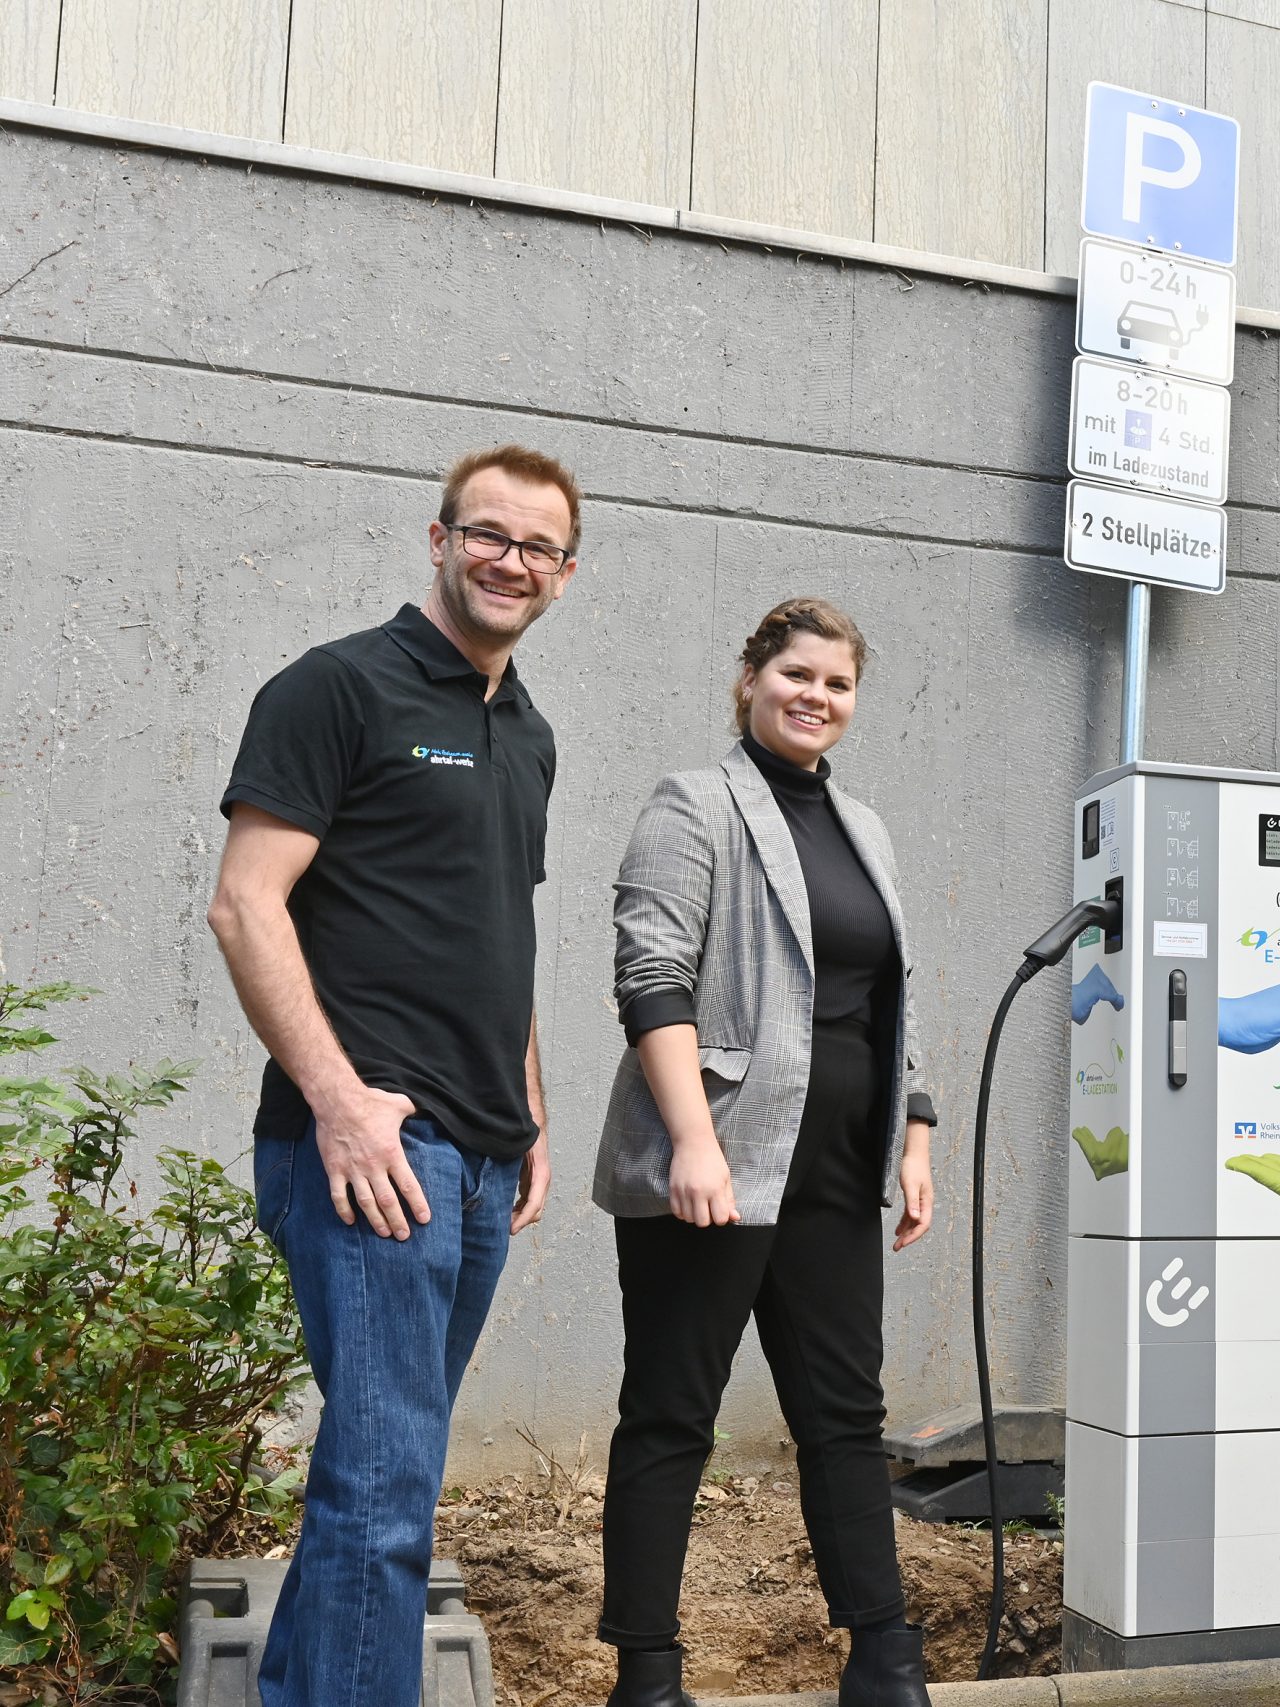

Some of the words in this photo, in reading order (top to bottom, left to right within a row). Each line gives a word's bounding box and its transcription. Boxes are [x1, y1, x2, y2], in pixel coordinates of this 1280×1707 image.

[1122, 111, 1202, 224] P
[1120, 261, 1181, 296] 0-24
[1185, 275, 1197, 299] h
[1117, 380, 1173, 412] 8-20
[1178, 392, 1188, 416] h
[1084, 414, 1117, 434] mit
[1158, 427, 1171, 446] 4
[1178, 431, 1216, 456] Std.
[1088, 445, 1107, 468] im
[1113, 450, 1209, 489] Ladezustand
[1081, 512, 1094, 538] 2
[1101, 516, 1212, 560] Stellplätze
